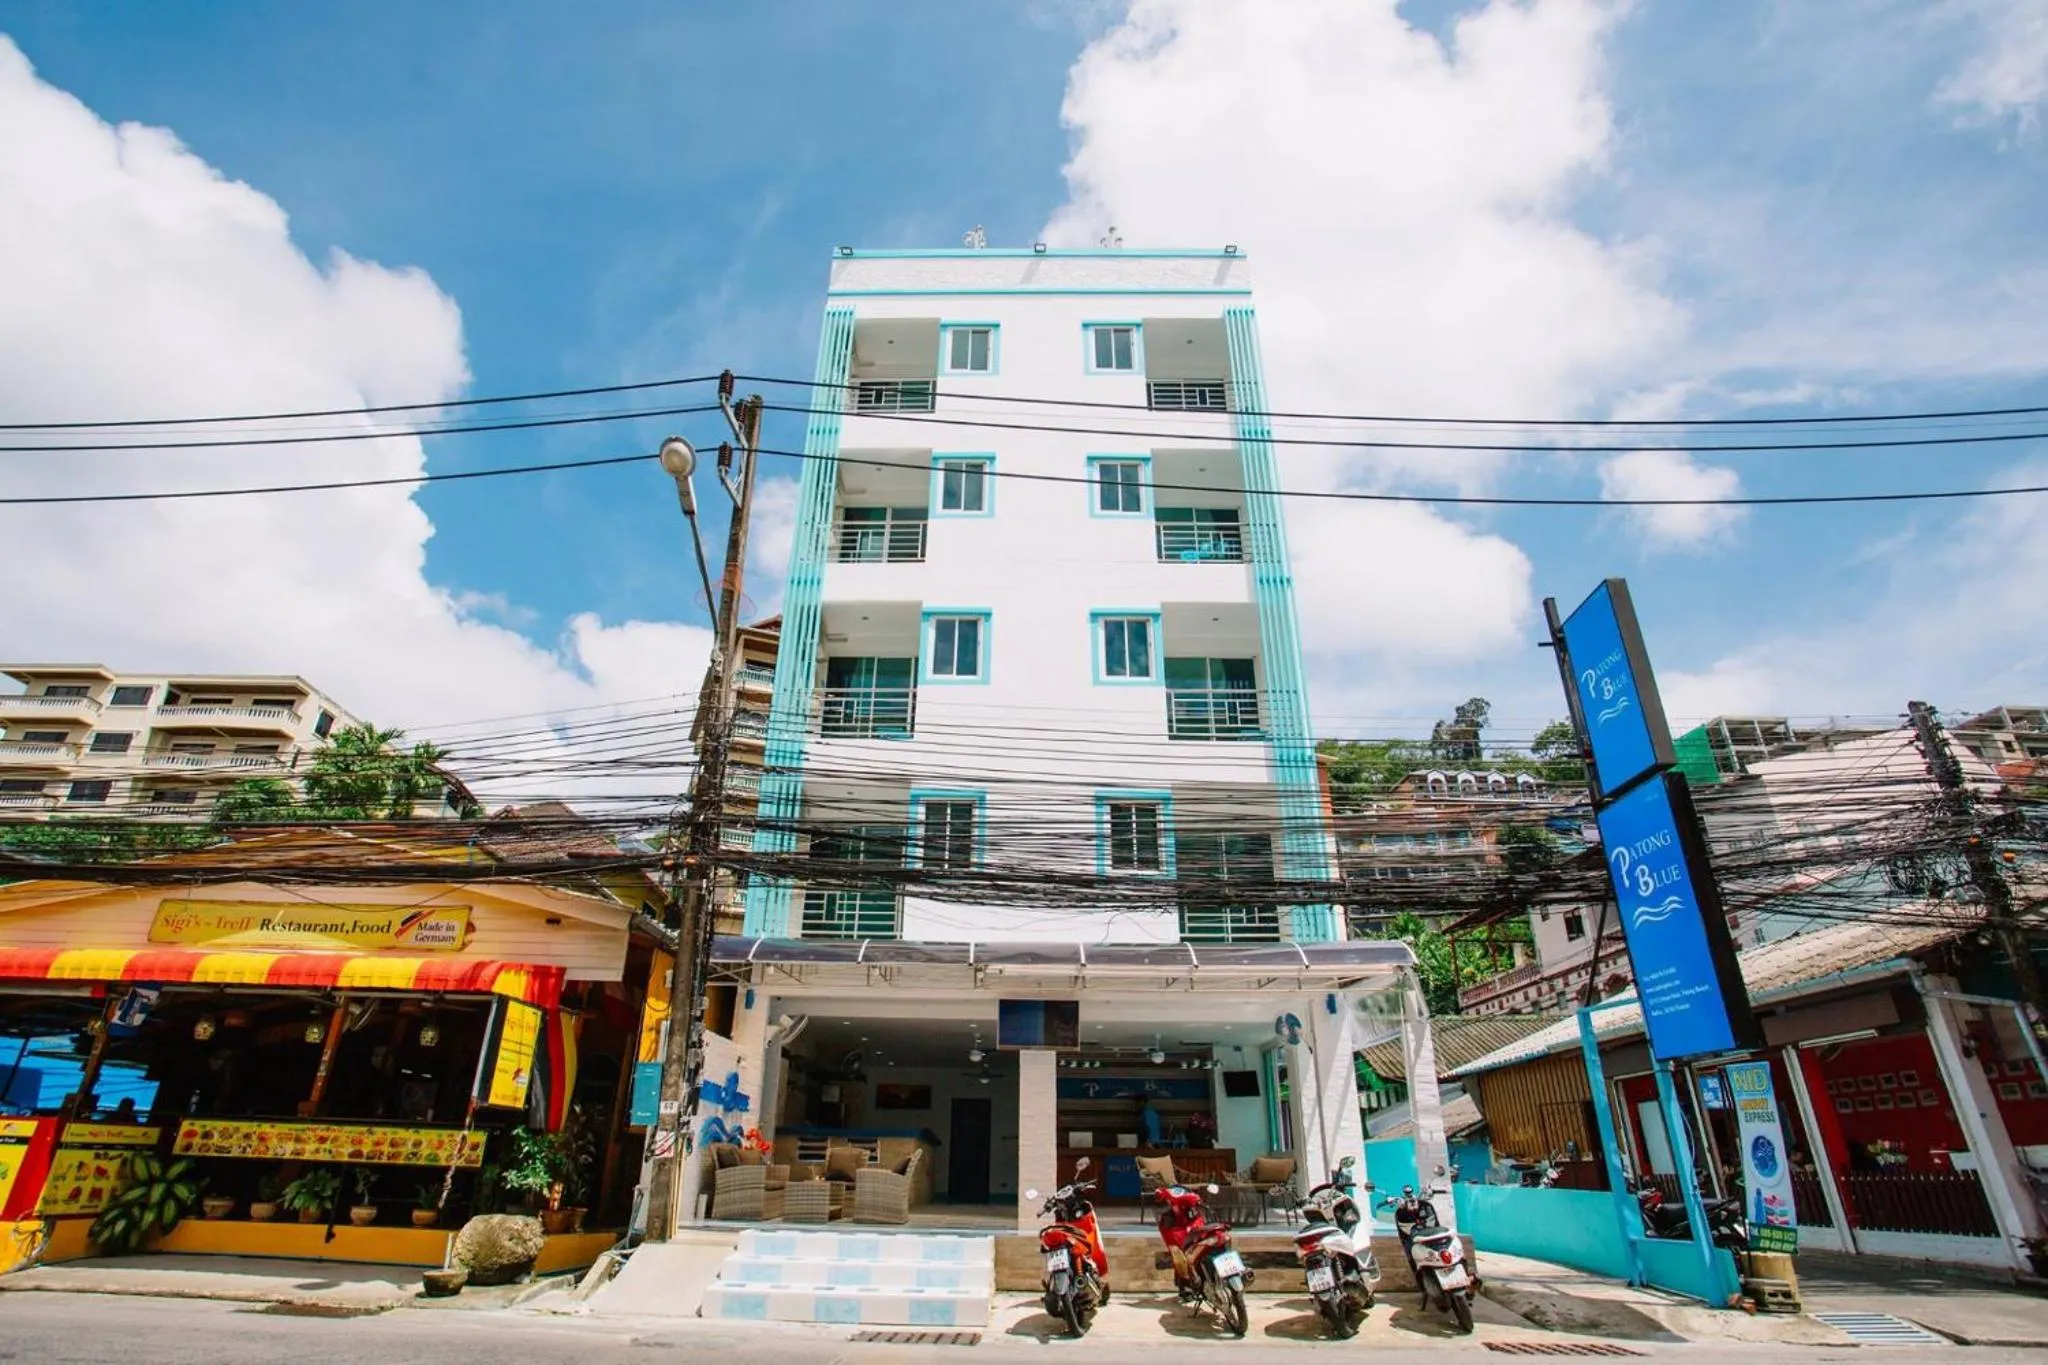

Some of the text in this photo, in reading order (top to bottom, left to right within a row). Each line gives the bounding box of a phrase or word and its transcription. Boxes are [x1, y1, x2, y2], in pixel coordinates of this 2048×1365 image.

[1581, 648, 1622, 698] PATONG
[1601, 671, 1629, 700] BLUE
[1611, 829, 1672, 889] PATONG
[1635, 864, 1683, 897] BLUE
[215, 914, 253, 930] Treff
[417, 921, 456, 932] Made in
[414, 931, 456, 945] Germany
[1734, 1068, 1767, 1092] NID
[1744, 1110, 1777, 1123] EXPRESS
